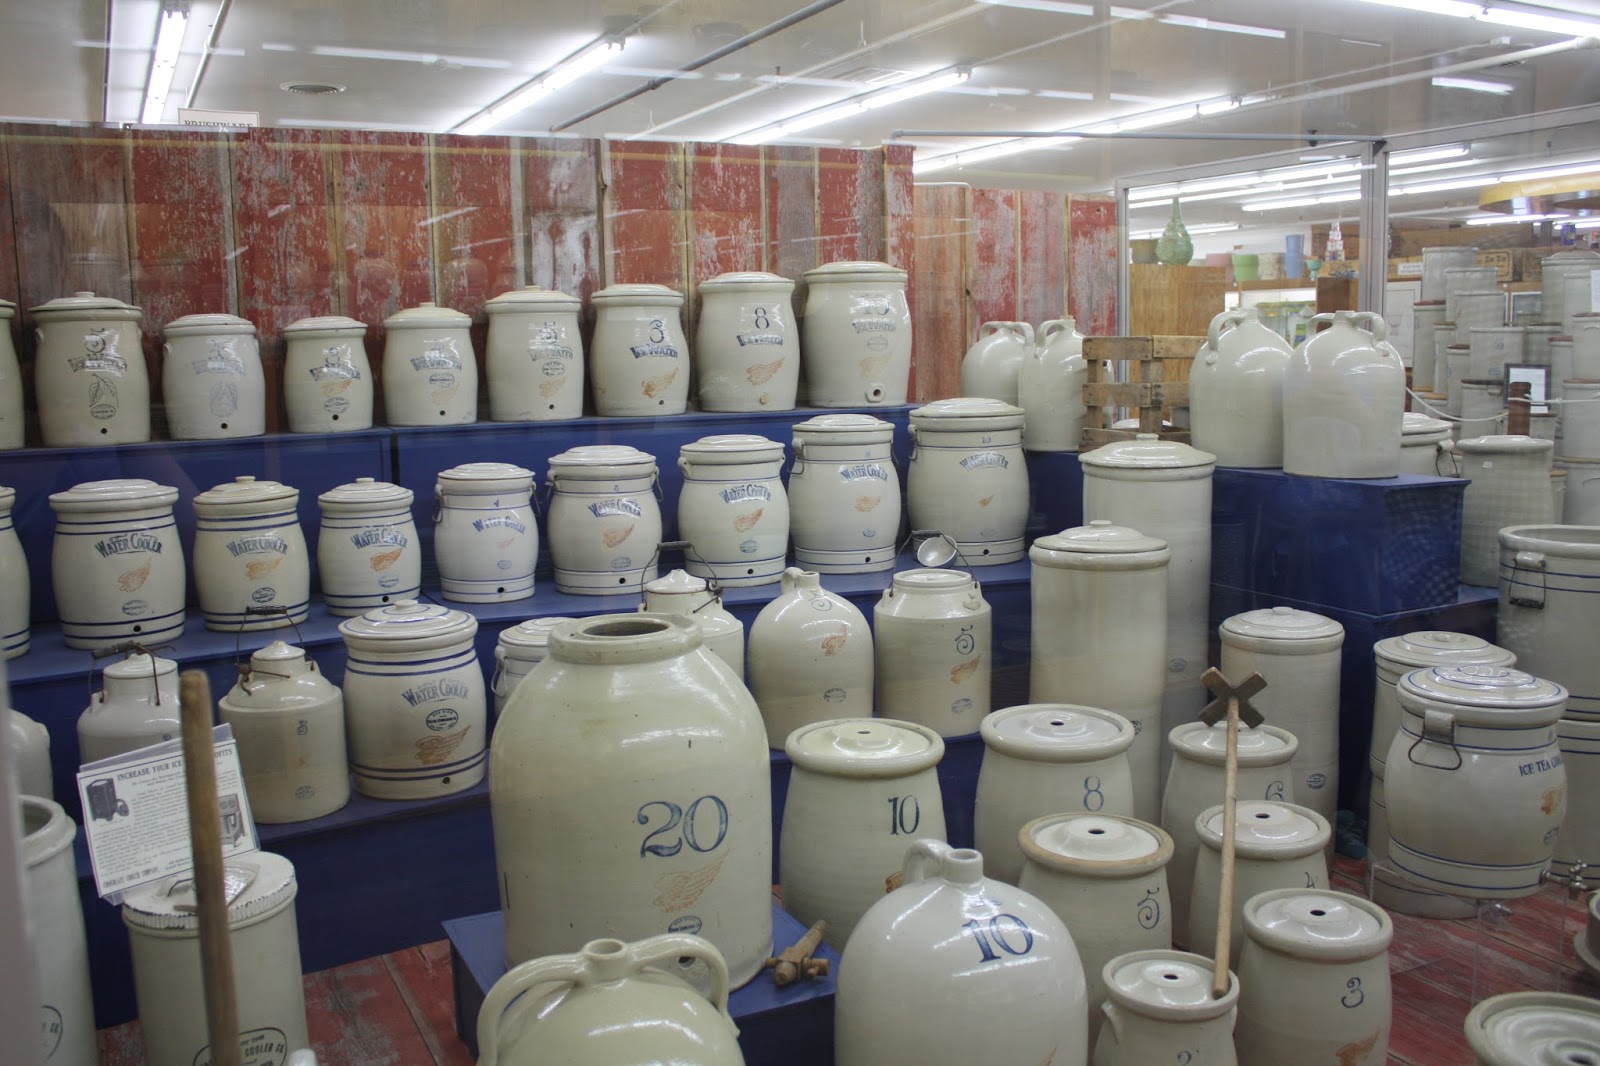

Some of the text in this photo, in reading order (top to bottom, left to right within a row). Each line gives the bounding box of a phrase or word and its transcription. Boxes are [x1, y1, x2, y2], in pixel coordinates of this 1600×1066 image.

[755, 307, 769, 330] 8
[94, 532, 162, 558] WATER COOLER
[226, 540, 258, 557] WATER
[955, 624, 975, 655] 5
[401, 678, 469, 707] WATER COOLER
[117, 766, 150, 782] INCREASE
[152, 762, 170, 774] YOUR
[171, 760, 183, 770] ICE
[1519, 763, 1534, 777] ICE
[1536, 759, 1551, 773] TEA
[1083, 776, 1104, 812] 8
[637, 795, 729, 858] 20
[888, 794, 920, 836] 10
[1137, 887, 1160, 929] 5
[962, 913, 1034, 963] 10
[1341, 976, 1365, 1008] 3
